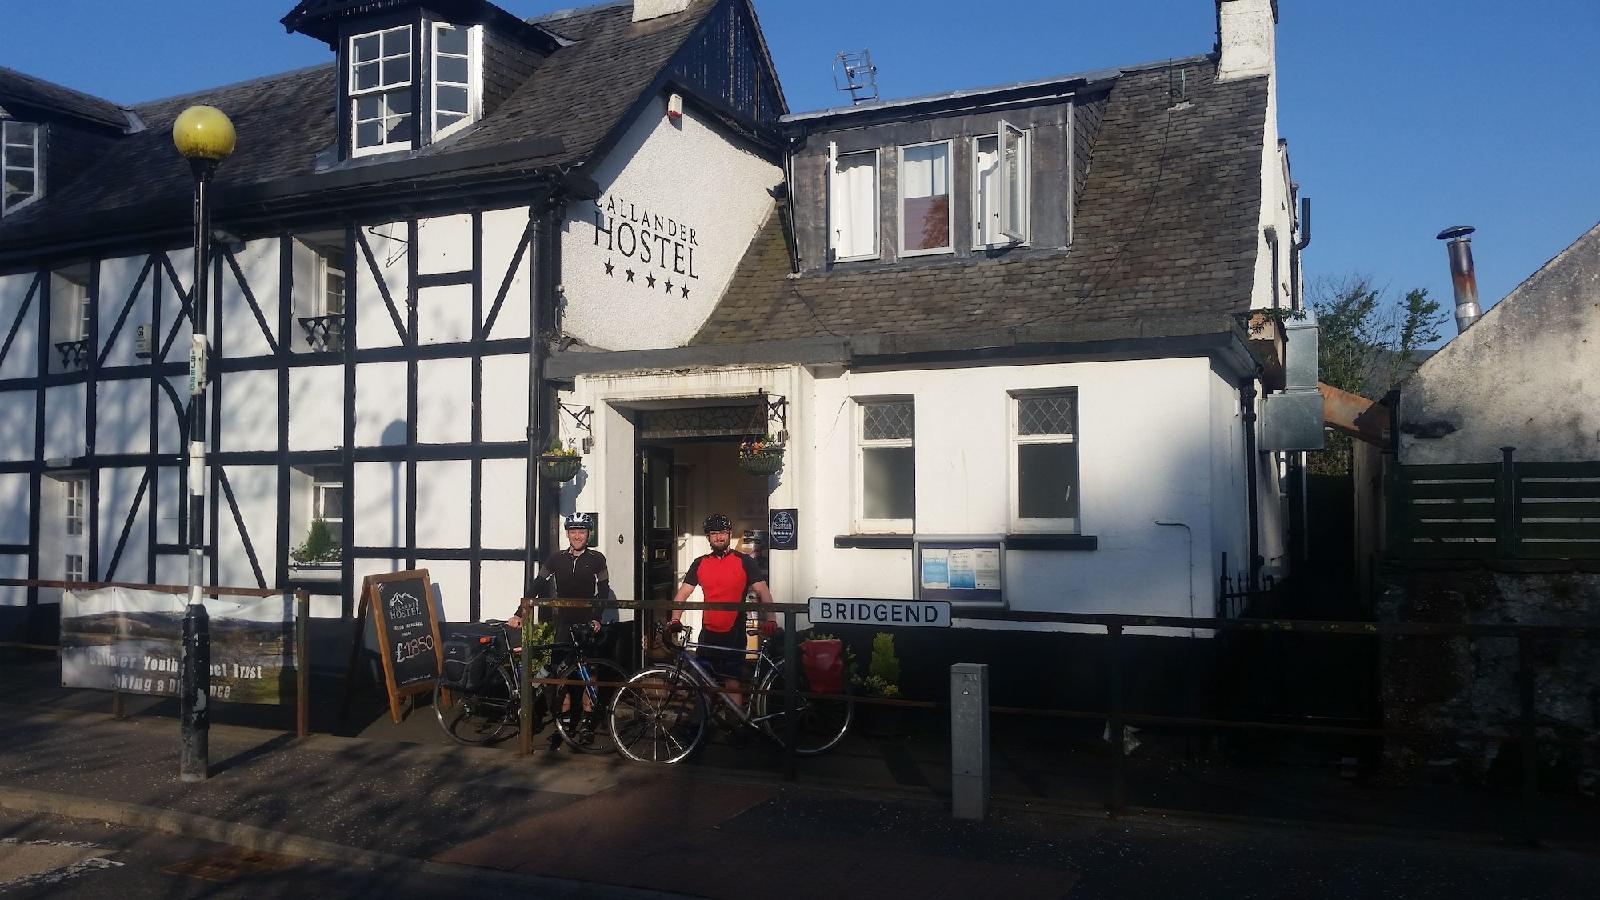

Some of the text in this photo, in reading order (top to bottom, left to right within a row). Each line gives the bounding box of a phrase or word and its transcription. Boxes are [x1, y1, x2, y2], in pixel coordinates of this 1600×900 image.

[594, 210, 699, 280] HOSTEL
[390, 607, 421, 619] HOSTEL
[821, 602, 938, 623] BRIDGEND
[144, 655, 179, 673] Youth
